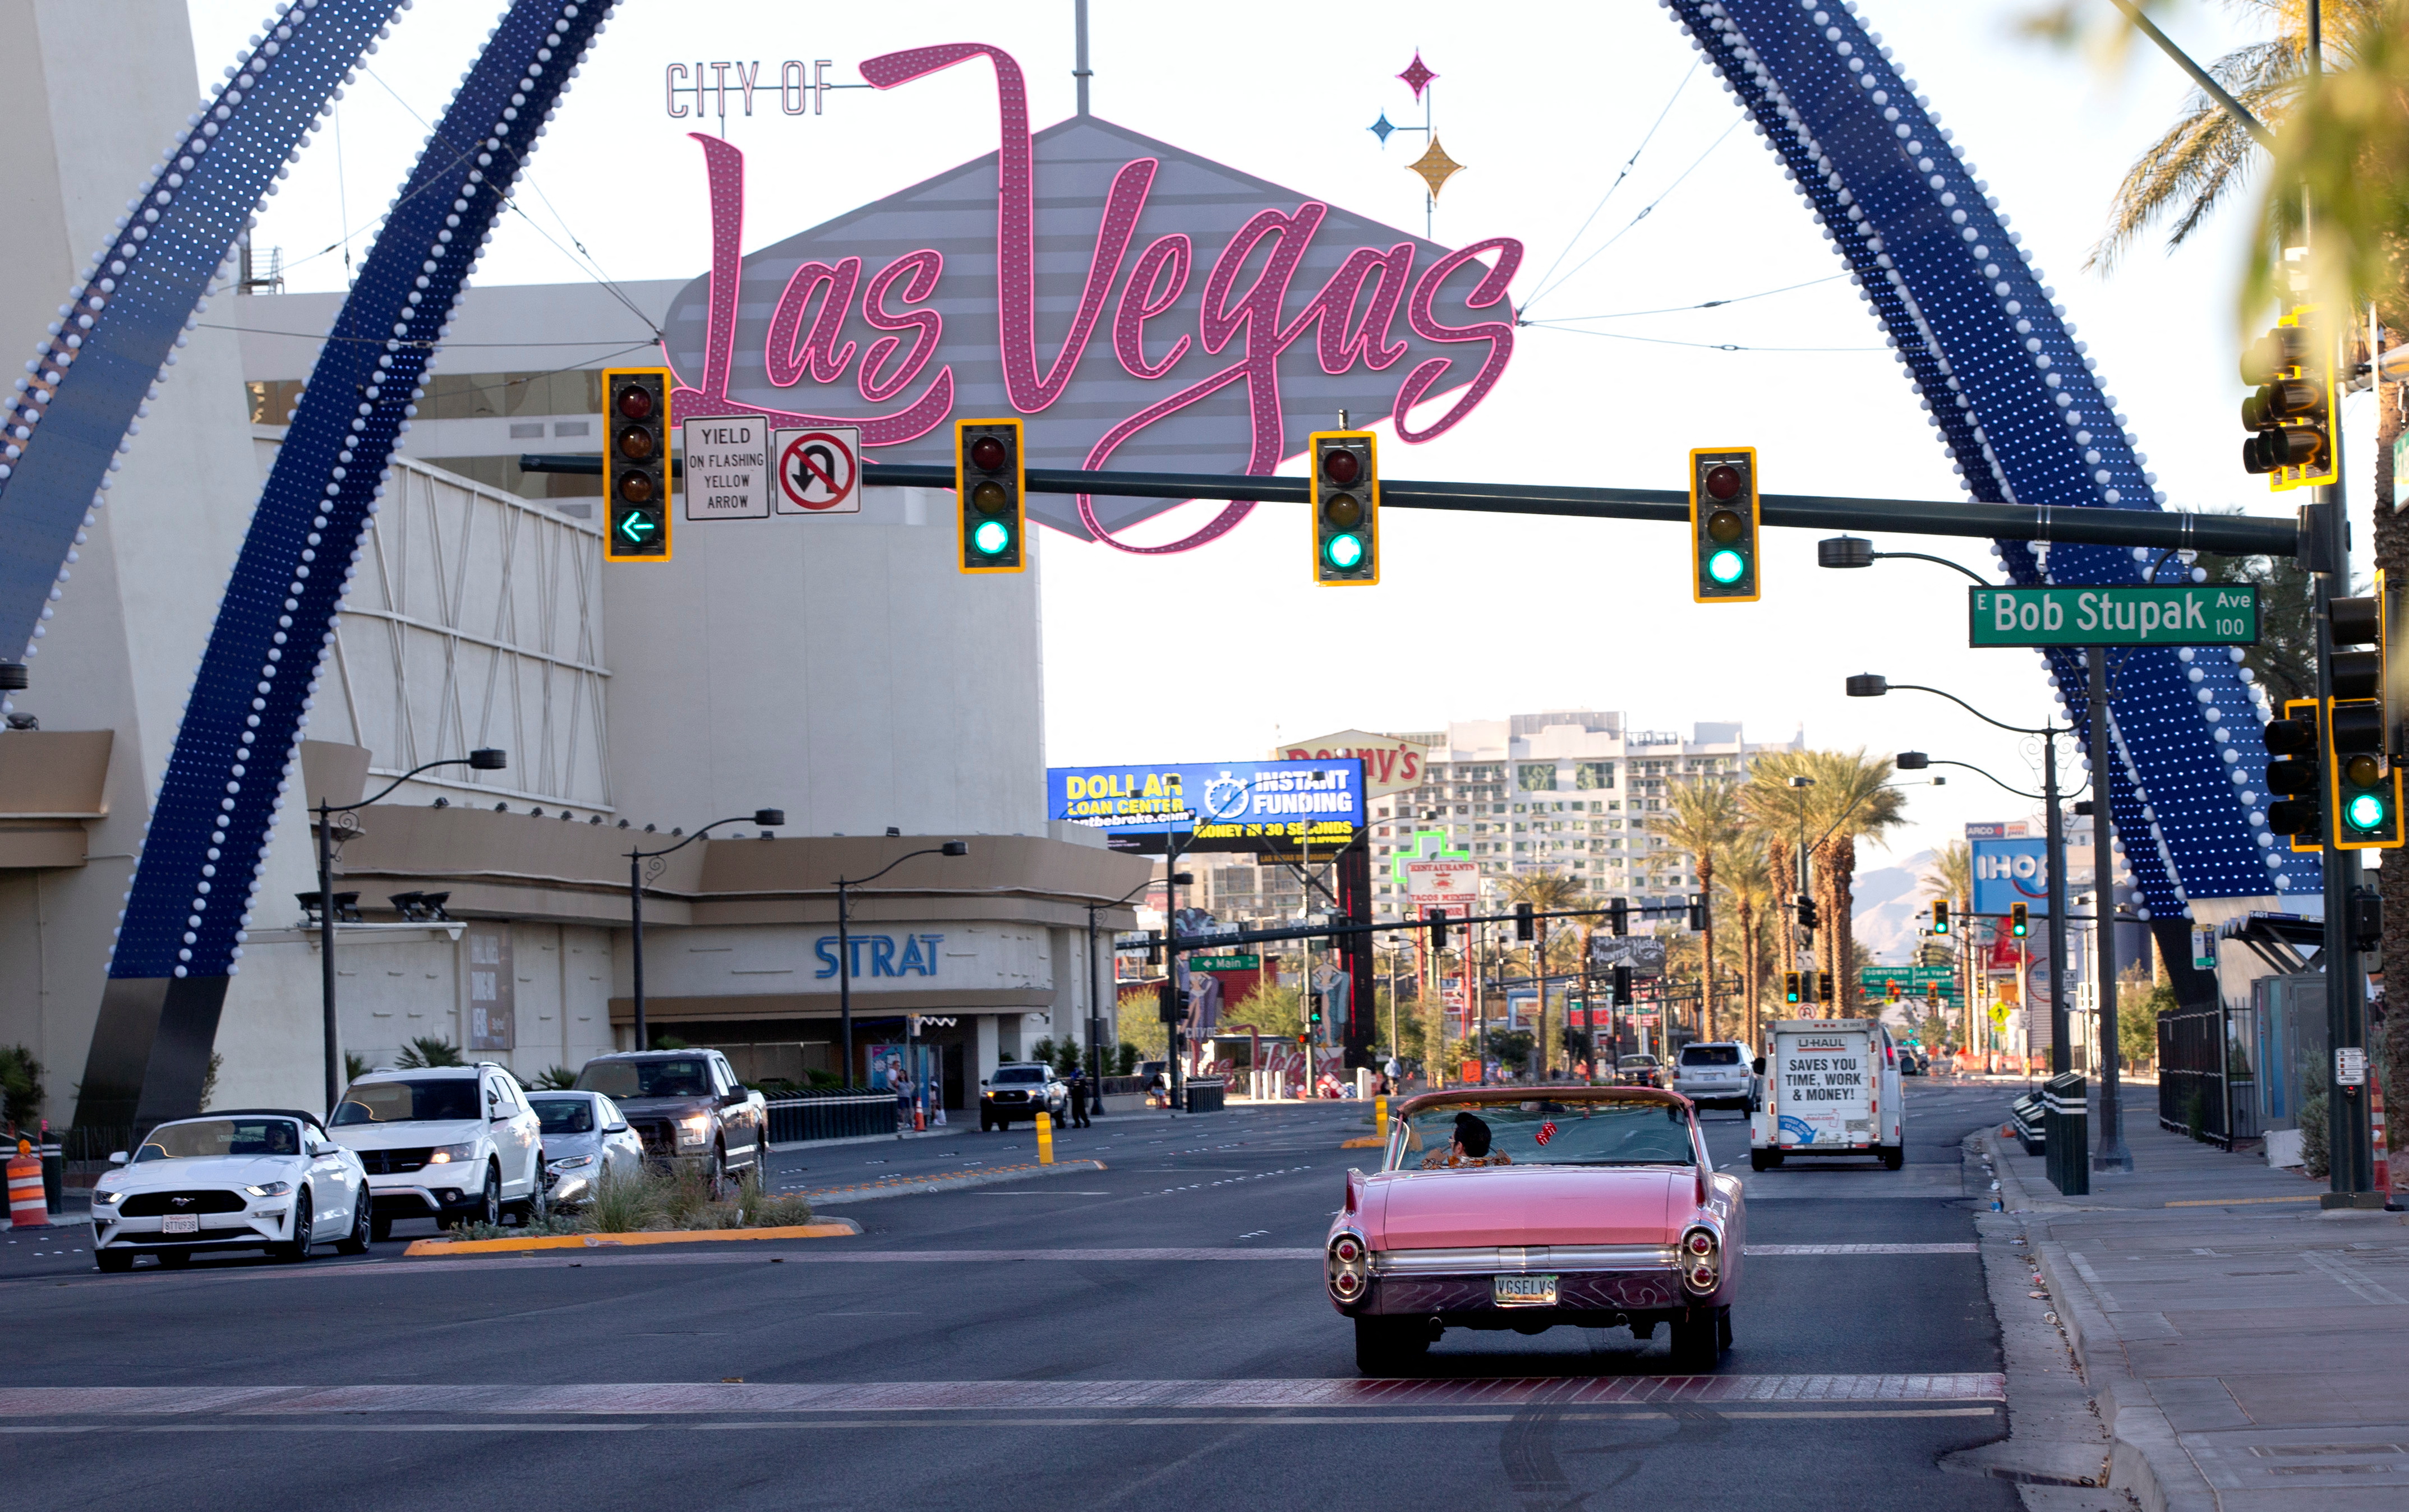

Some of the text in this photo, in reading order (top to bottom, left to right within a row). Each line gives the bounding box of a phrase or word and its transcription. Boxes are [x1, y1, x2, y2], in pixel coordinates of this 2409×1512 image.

[666, 59, 832, 118] CITY OF
[670, 43, 1523, 554] Las Vegas
[702, 428, 750, 444] YIELD
[690, 453, 763, 468] ON FLASHING
[704, 475, 750, 488] YELLOW
[708, 495, 748, 509] ARROW
[1978, 592, 2251, 639] E Bob Stupak Ave
[2216, 619, 2244, 635] 100
[1067, 773, 1183, 799] DOLLAR
[1068, 799, 1184, 815] LOAN CENTER
[1254, 792, 1353, 814] FUNDING
[1265, 823, 1284, 836] 30
[816, 933, 945, 979] STRAT
[1216, 958, 1241, 968] Main
[1185, 1027, 1205, 1038] CITY
[1789, 1058, 1856, 1071] SAVES YOU
[1786, 1073, 1861, 1087] TIME, WORK
[1793, 1088, 1854, 1100] & MONEY!
[1498, 1280, 1554, 1296] VGSELVS
